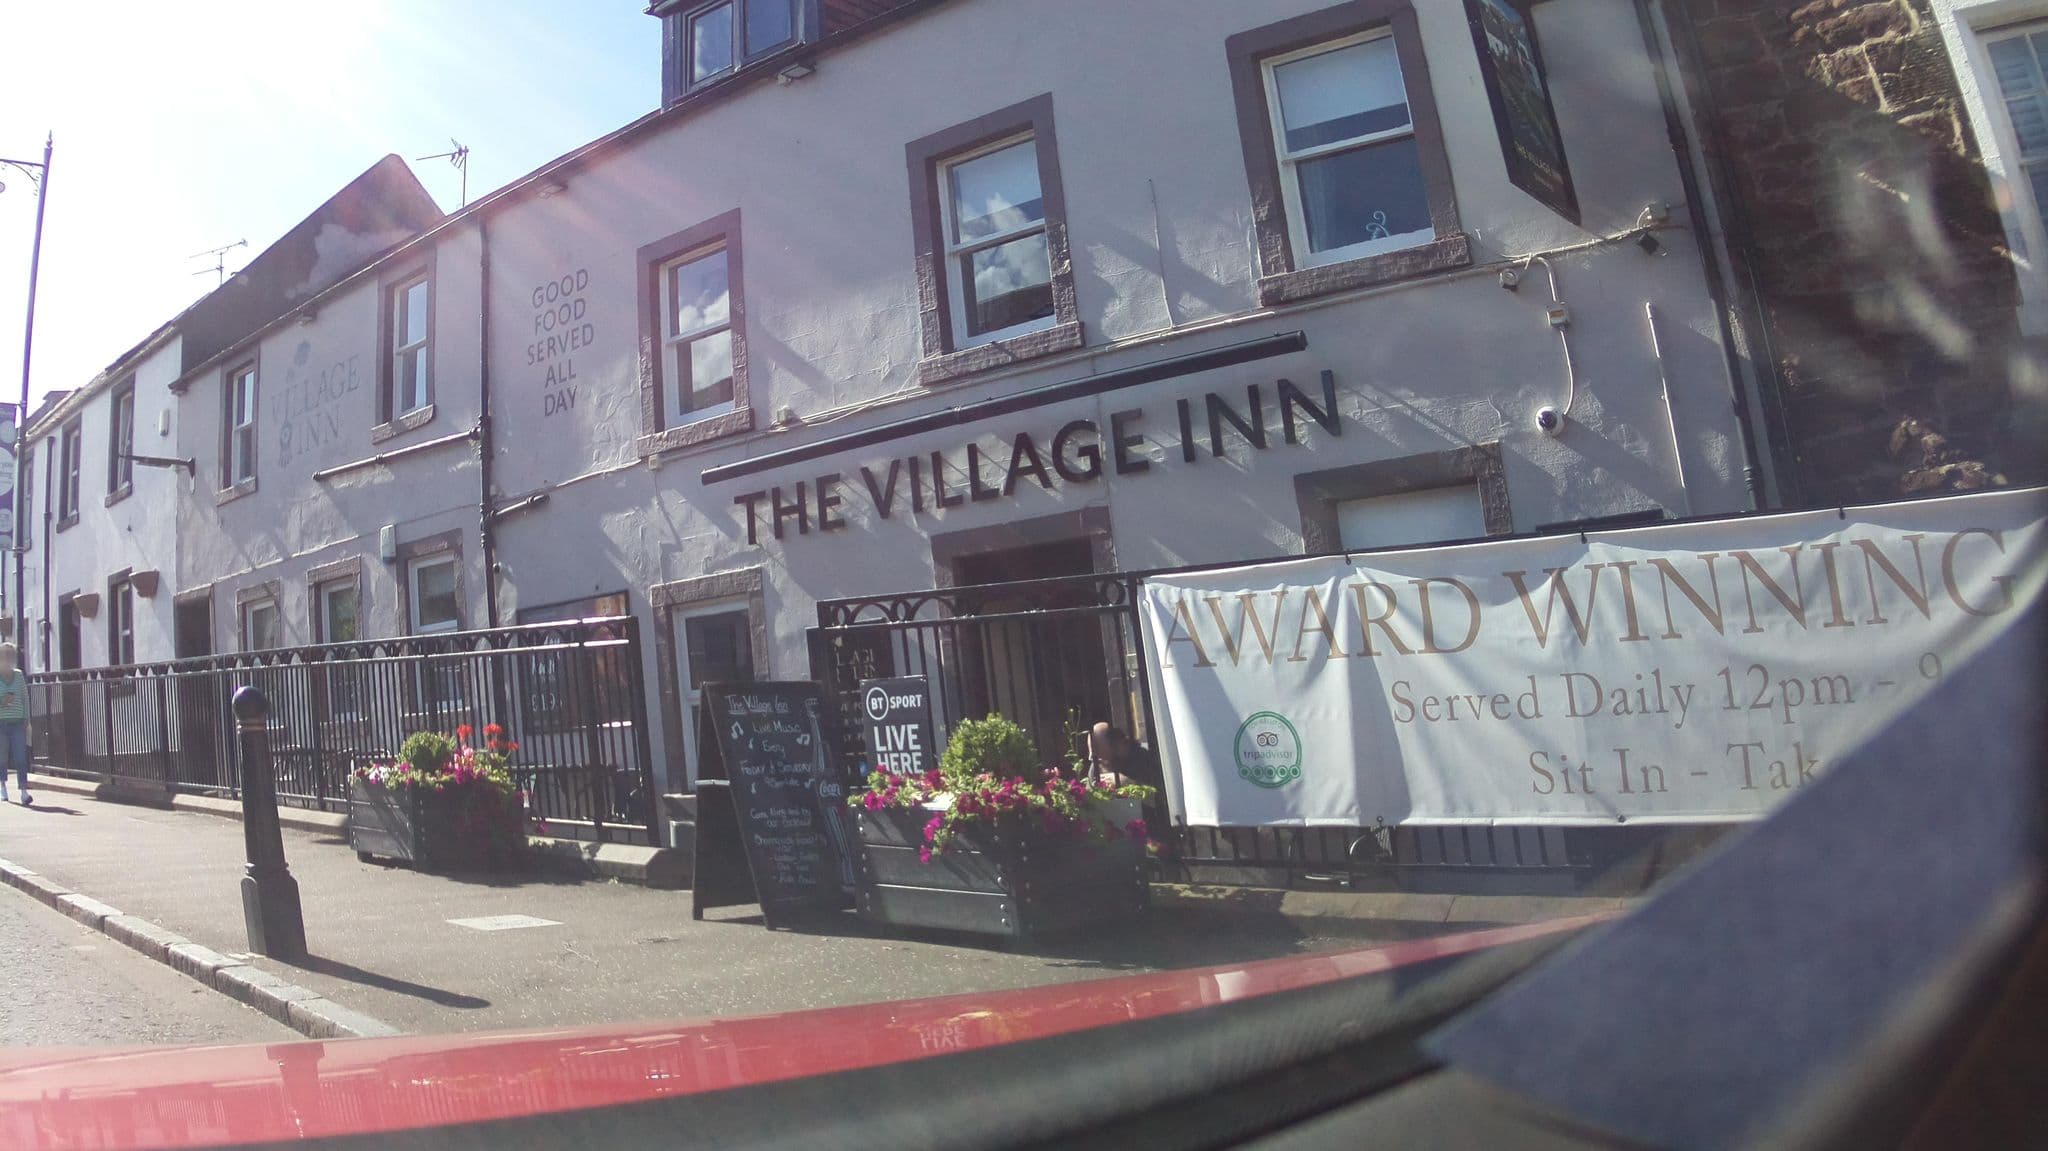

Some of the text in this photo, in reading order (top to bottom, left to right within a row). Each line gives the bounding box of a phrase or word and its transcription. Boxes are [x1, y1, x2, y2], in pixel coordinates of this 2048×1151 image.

[532, 268, 589, 309] GOOD
[534, 298, 586, 336] FOOD
[527, 323, 595, 366] SERVED
[270, 353, 361, 426] VILLAGE
[544, 358, 577, 388] ALL
[544, 385, 578, 417] DAY
[296, 408, 346, 456] INN
[734, 369, 1343, 545] THE VILLAGE INN
[1163, 527, 2018, 669] AWARD WINNING
[871, 694, 922, 711] BT SPORT
[1391, 673, 1543, 723] Served
[1560, 668, 1696, 729] Daily
[1718, 663, 1856, 725] 12pm
[873, 724, 922, 752] LIVE
[1243, 748, 1293, 762] tripadvisor
[877, 752, 925, 775] HERE
[1529, 750, 1594, 795] Sit
[1613, 748, 1668, 794] In
